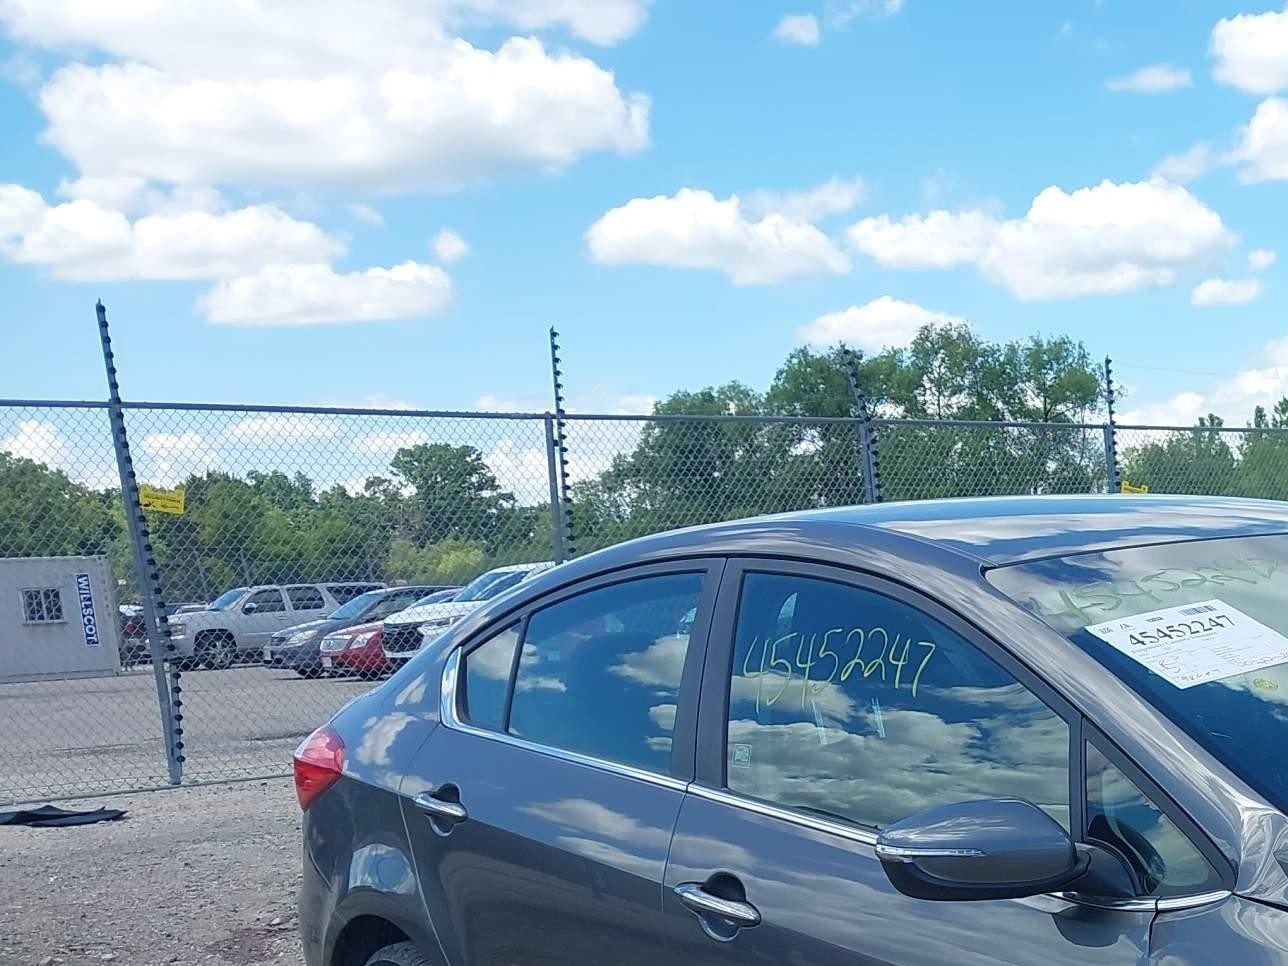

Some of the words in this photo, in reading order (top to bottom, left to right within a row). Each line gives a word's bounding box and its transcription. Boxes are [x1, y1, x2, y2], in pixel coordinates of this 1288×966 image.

[77, 575, 97, 644] WILLSCOT
[1129, 614, 1235, 646] 45452247
[743, 627, 936, 715] 45452247
